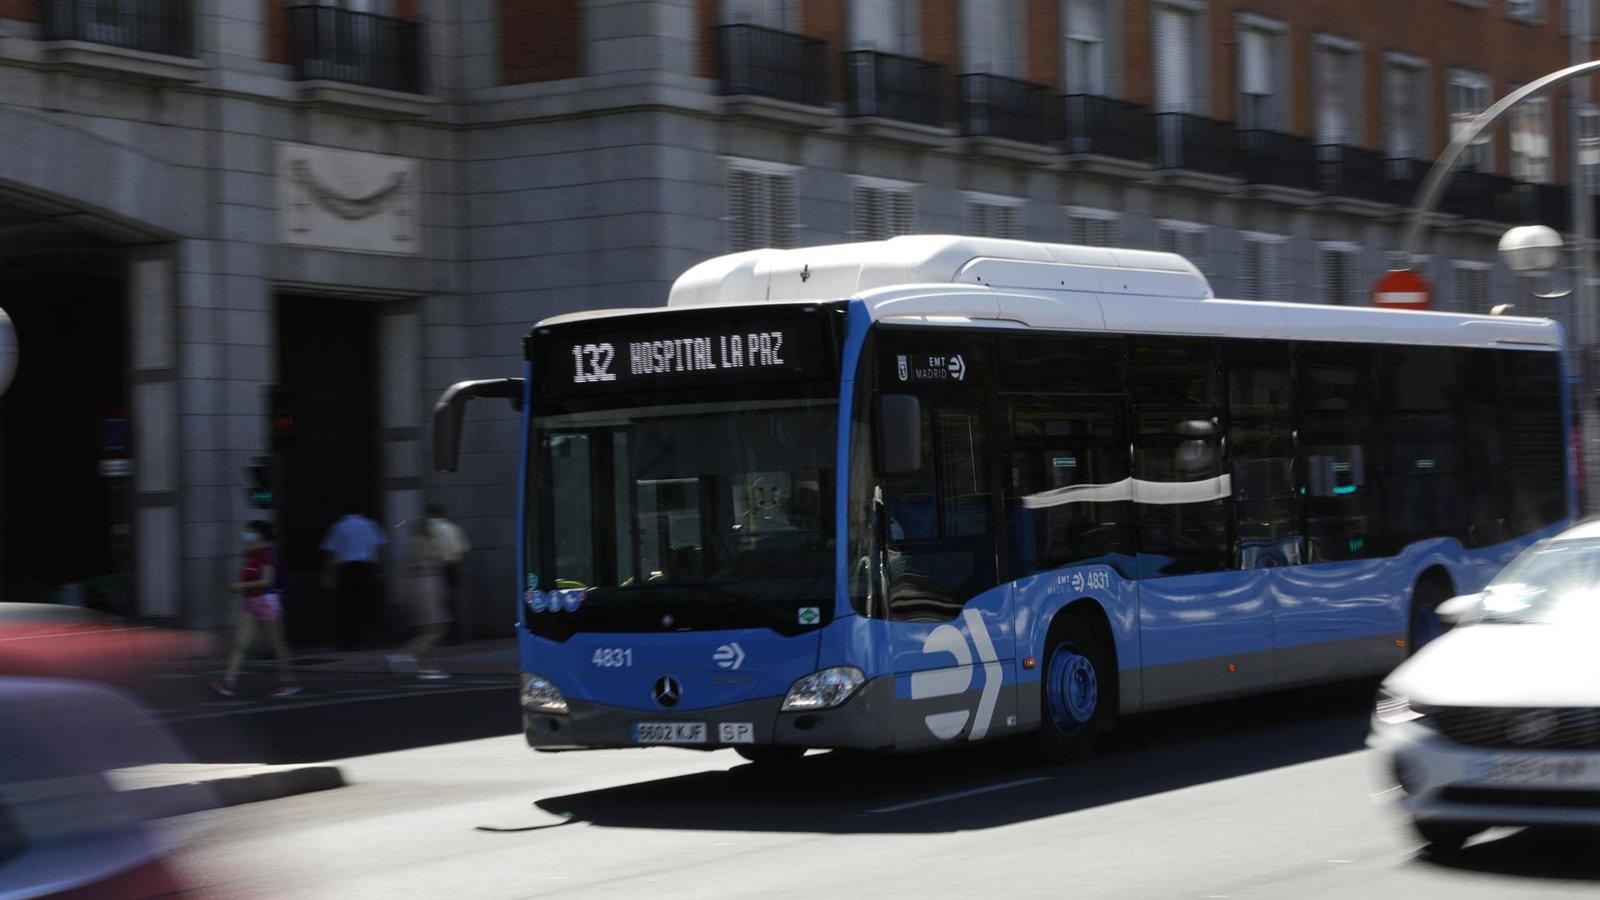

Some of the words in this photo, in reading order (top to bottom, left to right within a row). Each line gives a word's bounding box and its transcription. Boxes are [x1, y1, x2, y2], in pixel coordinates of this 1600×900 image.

[572, 343, 617, 383] 132
[629, 337, 717, 375] HOSPITAL
[720, 335, 743, 368] LA
[747, 331, 784, 366] PAZ
[928, 356, 946, 367] EMT
[915, 368, 947, 379] MADRID
[1057, 575, 1070, 585] EMT
[1087, 571, 1109, 590] 4831
[591, 648, 632, 667] 4831
